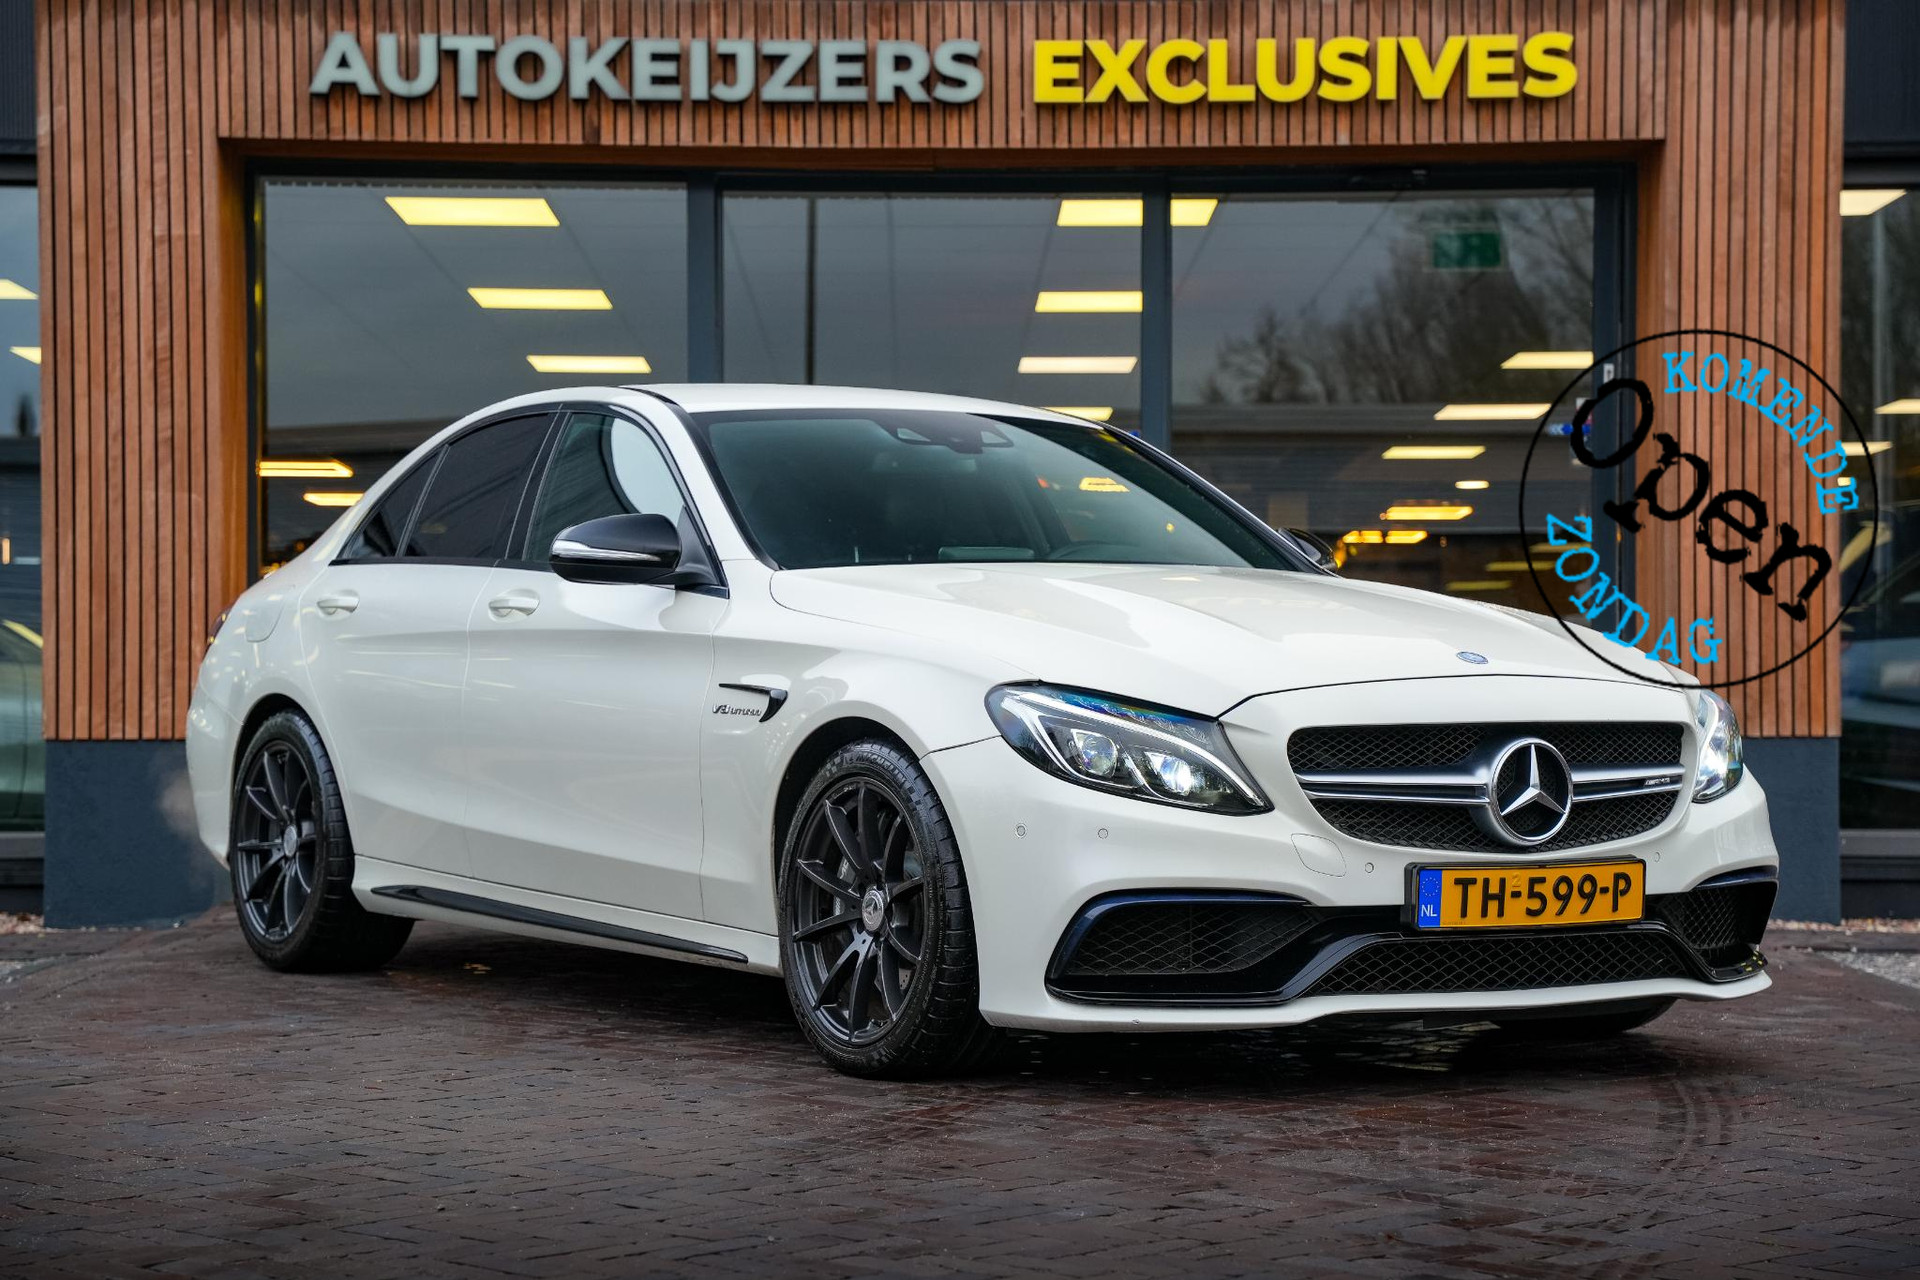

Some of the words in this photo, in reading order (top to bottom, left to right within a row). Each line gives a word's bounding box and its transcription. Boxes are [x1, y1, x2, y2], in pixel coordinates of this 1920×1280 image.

[310, 31, 984, 104] AUTOKEIJZERS
[1034, 30, 1578, 105] EXCLUSIVES
[1421, 904, 1438, 917] NL
[1453, 872, 1632, 918] TH-599-P
